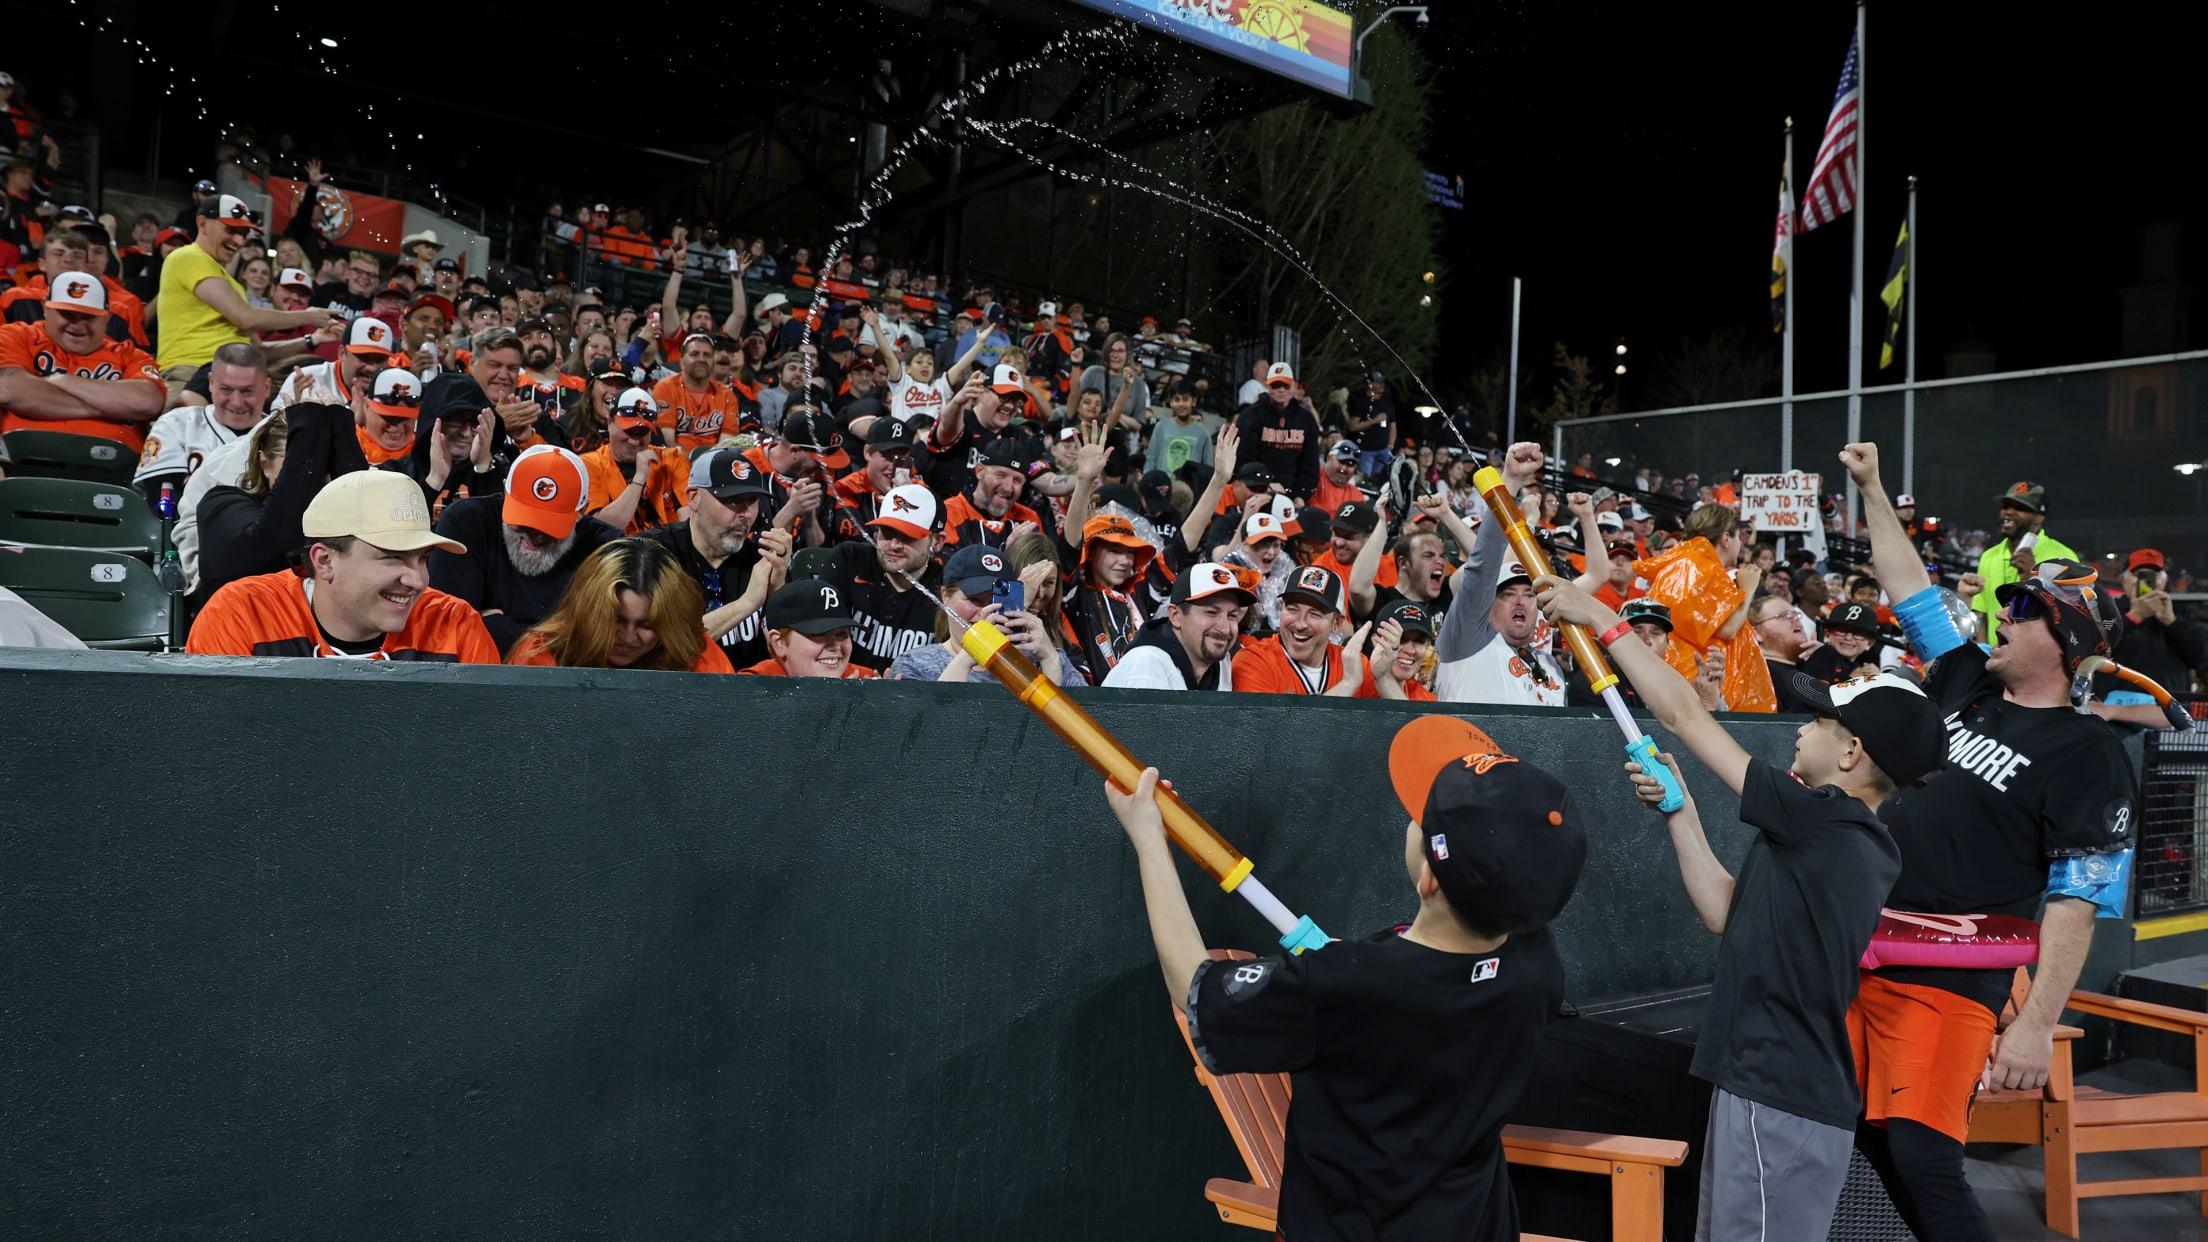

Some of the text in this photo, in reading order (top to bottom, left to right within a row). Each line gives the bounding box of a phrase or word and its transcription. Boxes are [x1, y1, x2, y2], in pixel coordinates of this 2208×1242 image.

[1228, 28, 1269, 51] VODKA
[891, 422, 903, 439] B
[103, 495, 113, 508] 8
[1744, 494, 1816, 508] TRIP TO THE
[983, 557, 1001, 568] 34
[103, 566, 113, 580] 8
[820, 586, 840, 610] B
[1845, 605, 1863, 621] B
[850, 607, 936, 660] ALTIMOR
[1943, 709, 2032, 792] IMORE
[2111, 807, 2130, 833] B
[1234, 965, 1264, 984] B
